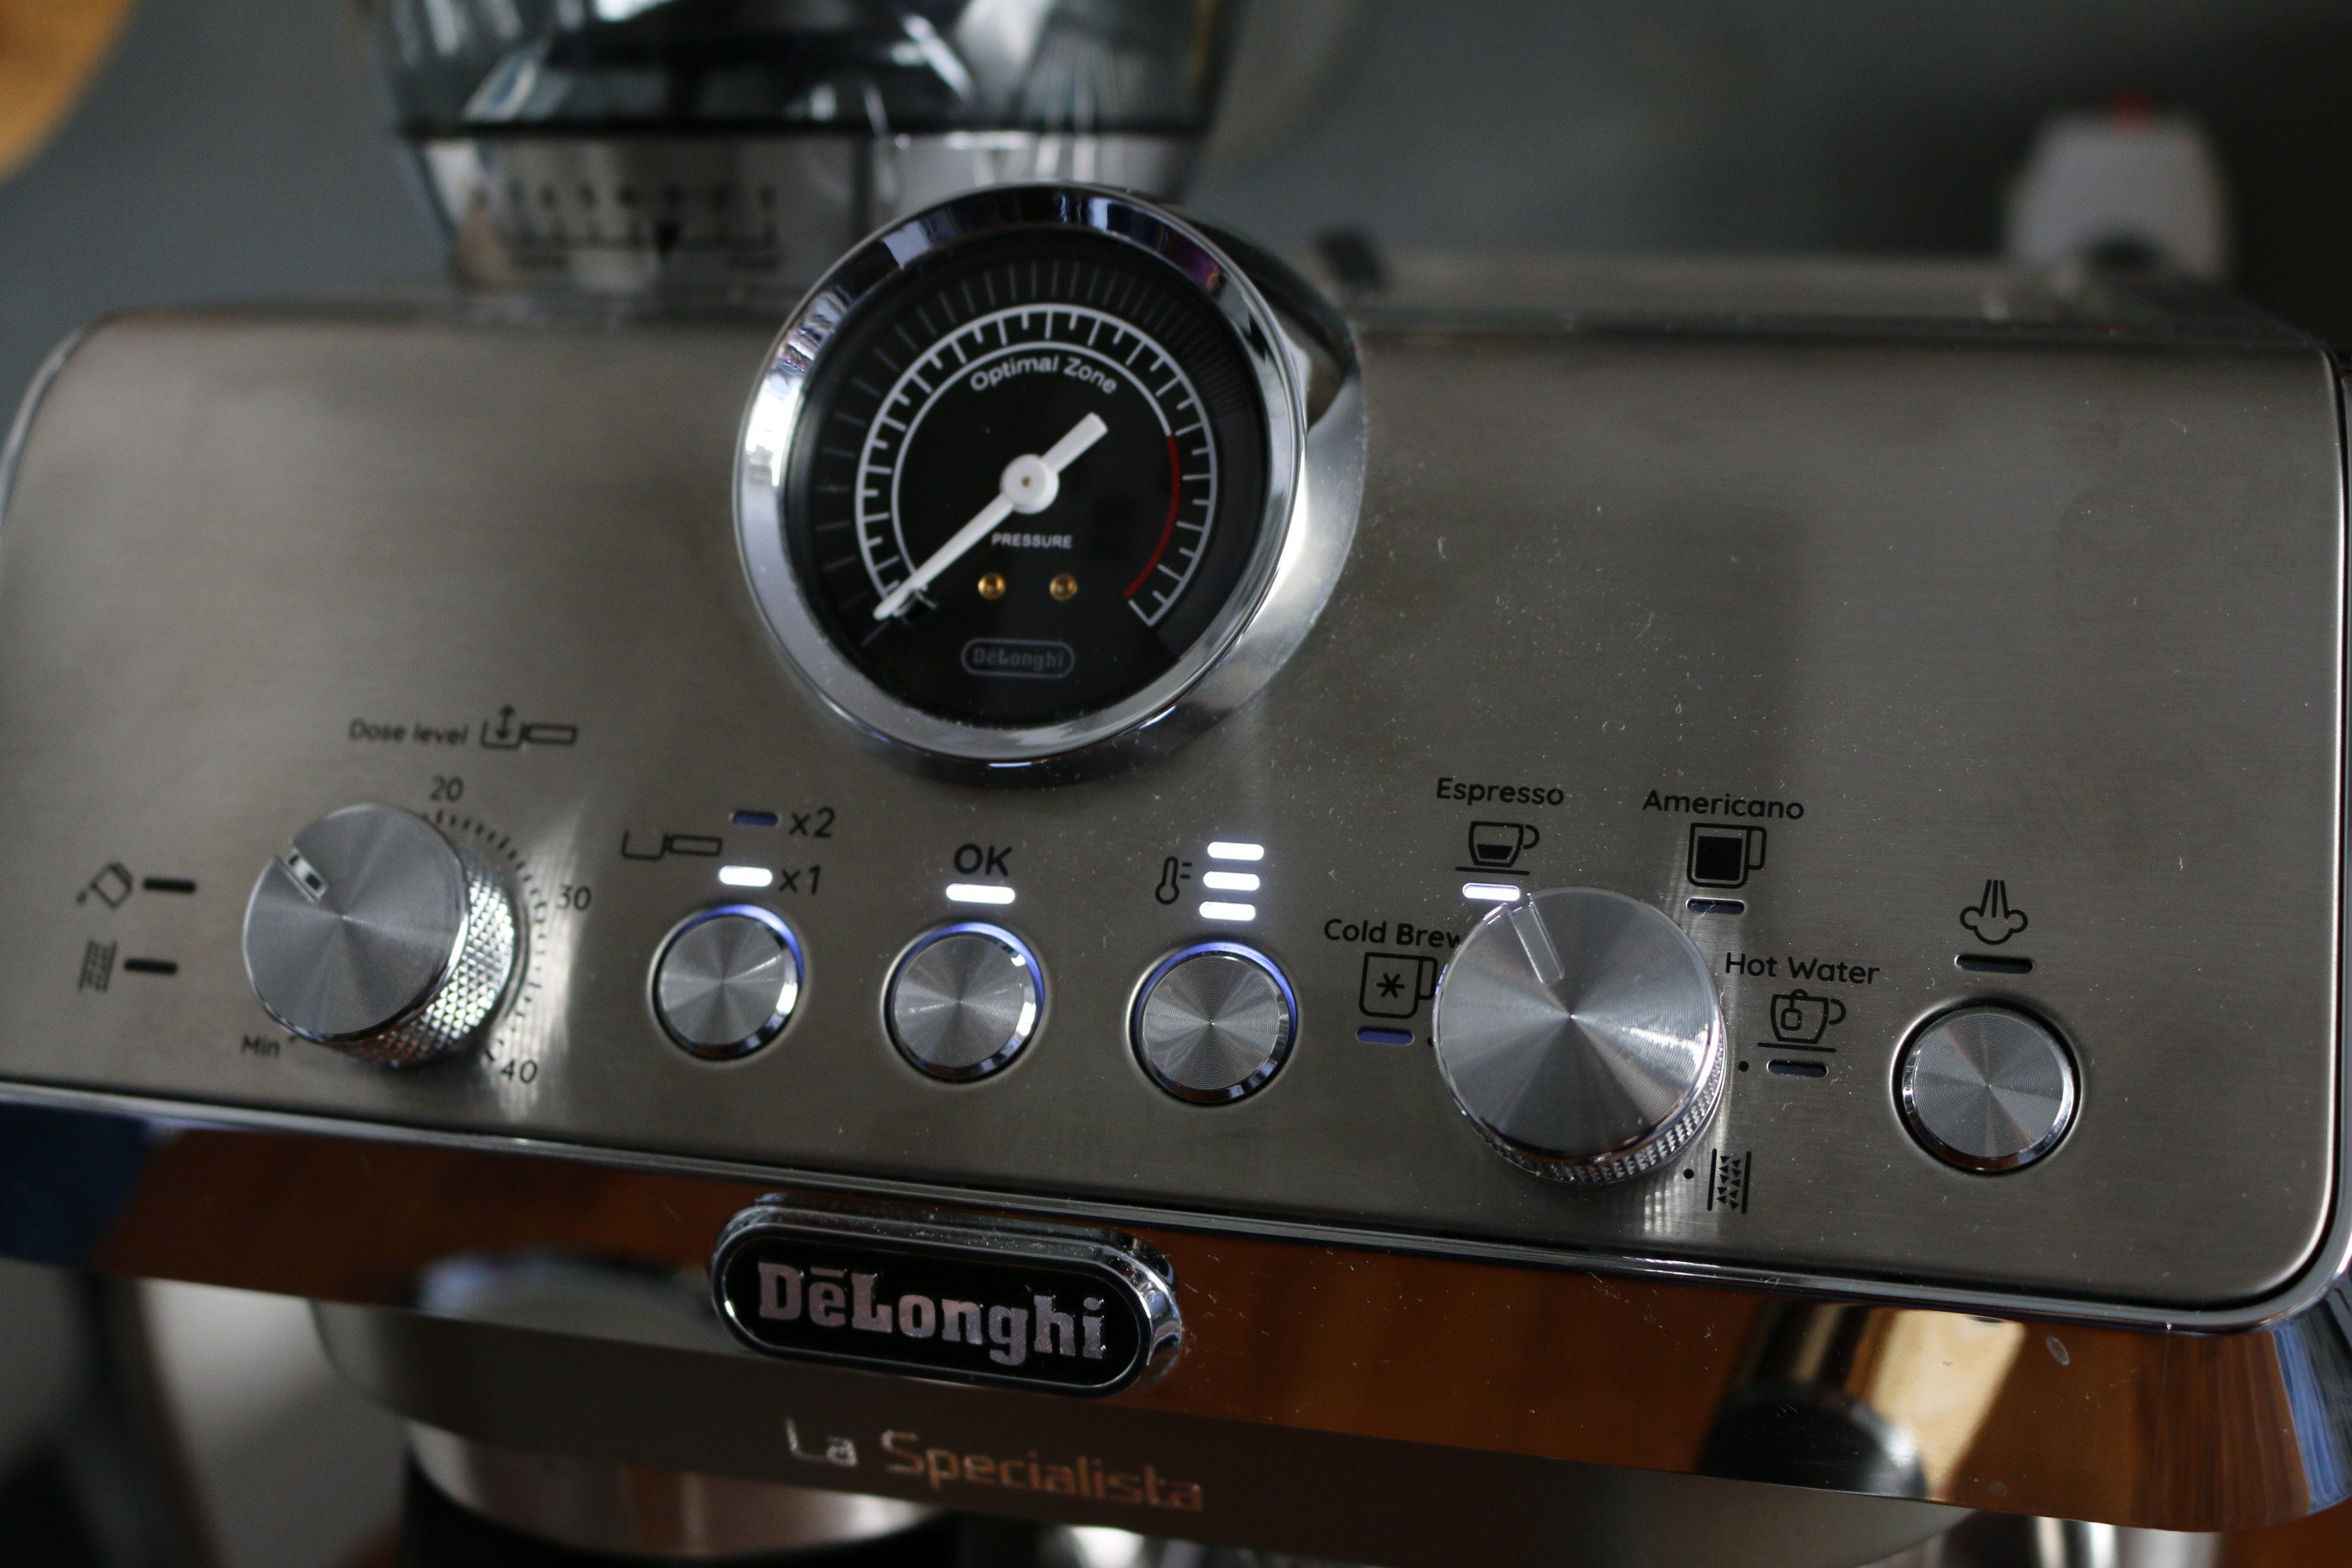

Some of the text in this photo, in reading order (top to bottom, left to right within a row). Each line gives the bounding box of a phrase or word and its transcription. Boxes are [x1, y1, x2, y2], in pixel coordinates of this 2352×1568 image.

[970, 356, 1118, 395] Optimal Zone
[991, 533, 1073, 549] PRESSURE
[348, 719, 469, 746] Dose level
[430, 775, 464, 801] 20
[1436, 777, 1565, 806] Espresso
[1642, 789, 1804, 820] Americano
[788, 806, 836, 838] x2
[953, 843, 1014, 877] OK
[778, 865, 822, 895] x1
[557, 885, 591, 912] 30
[1324, 918, 1387, 945] Cold
[1725, 952, 1880, 984] Hot Water
[241, 1034, 280, 1057] Min
[500, 1059, 538, 1085] 40
[786, 1418, 1203, 1511] La Specialista
